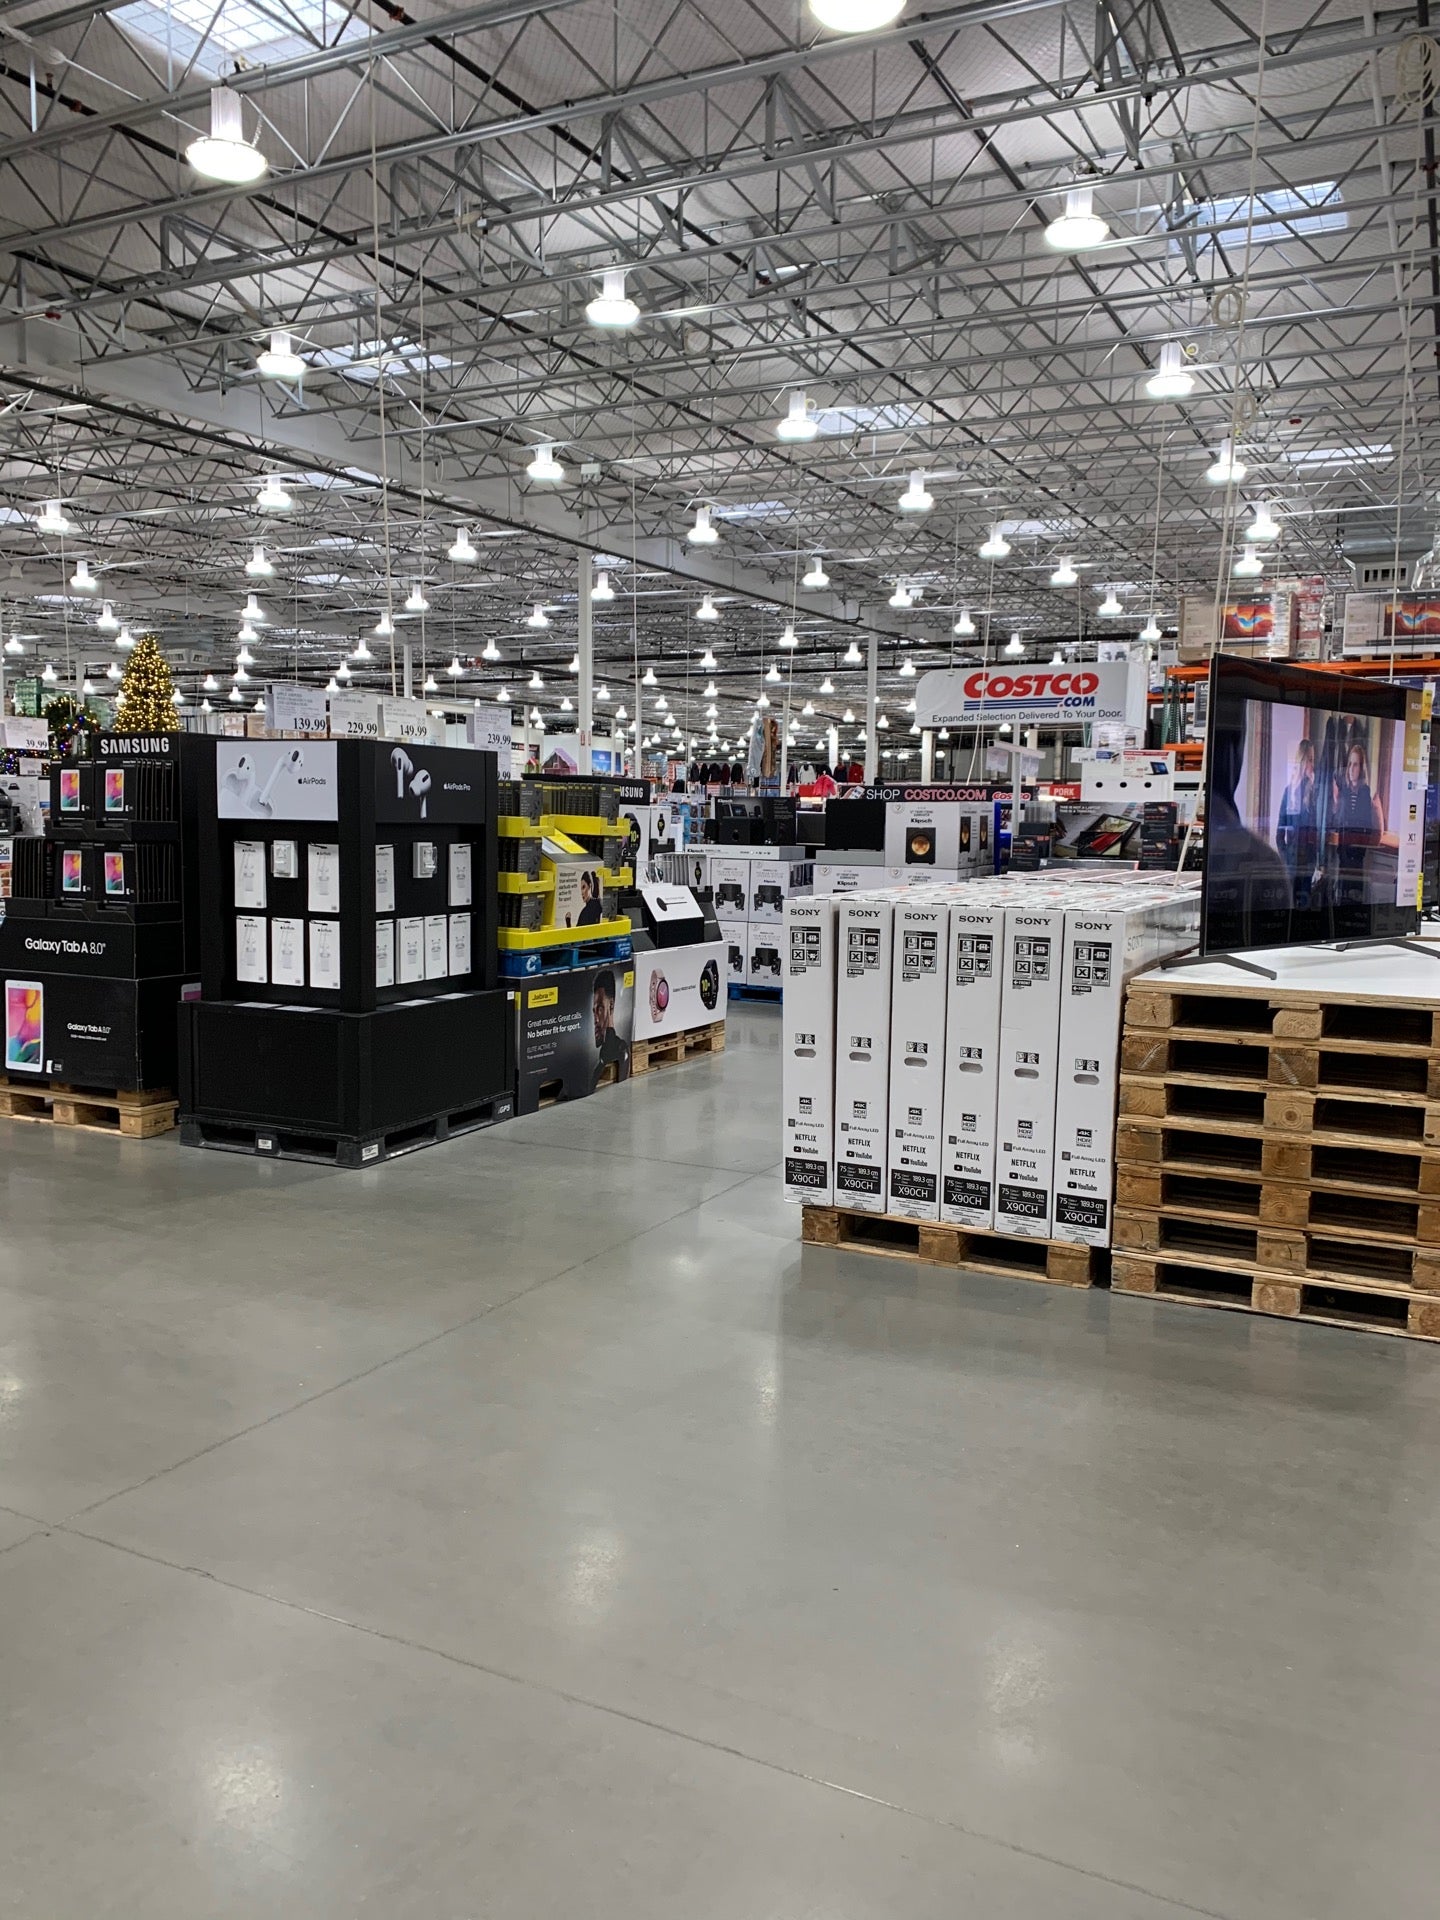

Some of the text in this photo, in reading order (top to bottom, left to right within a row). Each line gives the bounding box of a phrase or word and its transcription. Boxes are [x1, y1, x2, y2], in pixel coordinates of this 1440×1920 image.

[964, 672, 1099, 698] COSTCO
[1060, 697, 1095, 707] .COM
[932, 709, 1123, 723] Expanded Selection Delivered To Your Door.
[294, 718, 326, 730] 139.99
[348, 721, 378, 734] 229.99
[400, 724, 427, 736] 149.99
[26, 739, 47, 748] 39.99
[488, 733, 511, 745] 239.99
[100, 737, 169, 754] SAMSUNG
[303, 777, 326, 785] AirPods
[620, 786, 643, 798] MSUNG
[866, 789, 987, 800] SHOP COSTCO.COM
[1054, 788, 1074, 796] PORK
[848, 910, 880, 918] SONY
[904, 913, 938, 921] SONY
[1015, 917, 1051, 925] SONY
[1075, 922, 1112, 930] SONY
[25, 937, 61, 954] Galaxy
[61, 940, 80, 953] Tab
[81, 942, 88, 953] A
[527, 1020, 542, 1028] Great
[558, 1014, 571, 1022] Great
[67, 1022, 88, 1033] Galaxy
[536, 1028, 552, 1037] better
[567, 1022, 581, 1032] sport.
[795, 1134, 816, 1142] NETFLIX
[848, 1138, 870, 1147] NETFLIX
[902, 1145, 926, 1154] NETFLIX
[856, 1152, 872, 1160] YouTube
[956, 1152, 980, 1161] NETFLIX
[910, 1159, 928, 1167] YouTube
[1011, 1159, 1036, 1169] NETFLIX
[858, 1167, 870, 1175] 189.3
[964, 1166, 981, 1174] YouTube
[1070, 1168, 1095, 1178] NETFLIX
[792, 1174, 820, 1184] X90CH
[912, 1175, 925, 1183] 189.3
[1019, 1174, 1038, 1182] YouTube
[844, 1179, 873, 1190] X90CH
[966, 1182, 979, 1190] 189.3
[1078, 1183, 1098, 1191] YouTube
[898, 1186, 928, 1198] X90CH
[1022, 1190, 1035, 1199] 189.3
[951, 1193, 982, 1205] X90CH
[1080, 1200, 1094, 1208] 189.3
[1006, 1202, 1038, 1214] X90CH
[1064, 1211, 1098, 1224] X90CH
